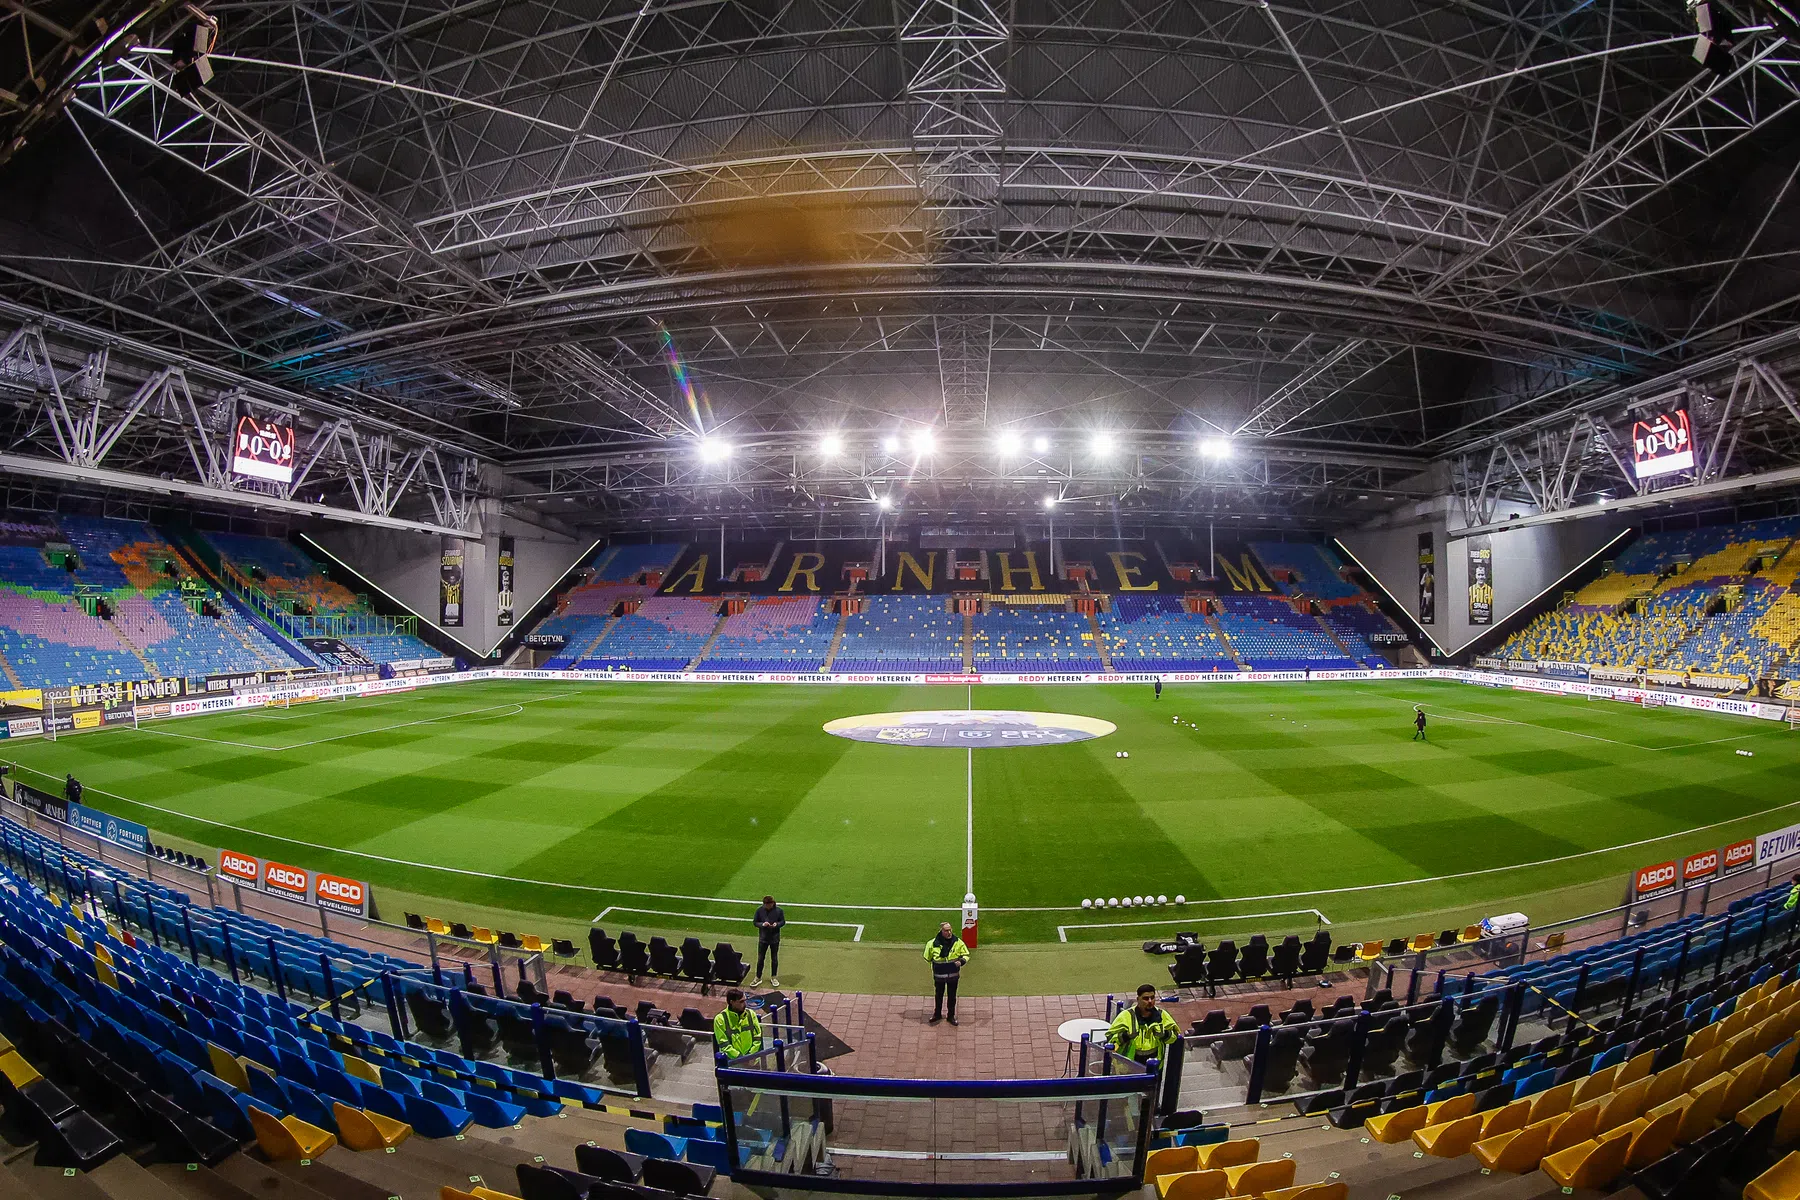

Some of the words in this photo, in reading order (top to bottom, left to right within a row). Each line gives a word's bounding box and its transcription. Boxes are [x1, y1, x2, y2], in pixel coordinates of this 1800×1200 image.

[663, 551, 1272, 593] ARNHEM
[74, 685, 123, 704] VITESSE
[135, 680, 180, 698] ARNHEM
[176, 702, 201, 712] REDDY
[202, 699, 234, 710] HETEREN
[1691, 697, 1715, 708] REDDY
[1716, 701, 1748, 712] HETEREN
[1685, 853, 1717, 874] ABCO
[1725, 843, 1753, 863] ABCO
[222, 855, 256, 876] ABCO
[267, 867, 305, 888] ABCO
[1638, 865, 1675, 888] ABCO
[267, 886, 305, 901] BEVEILIGING
[318, 879, 361, 900] ABCO
[318, 899, 361, 914] BEVEILIGING
